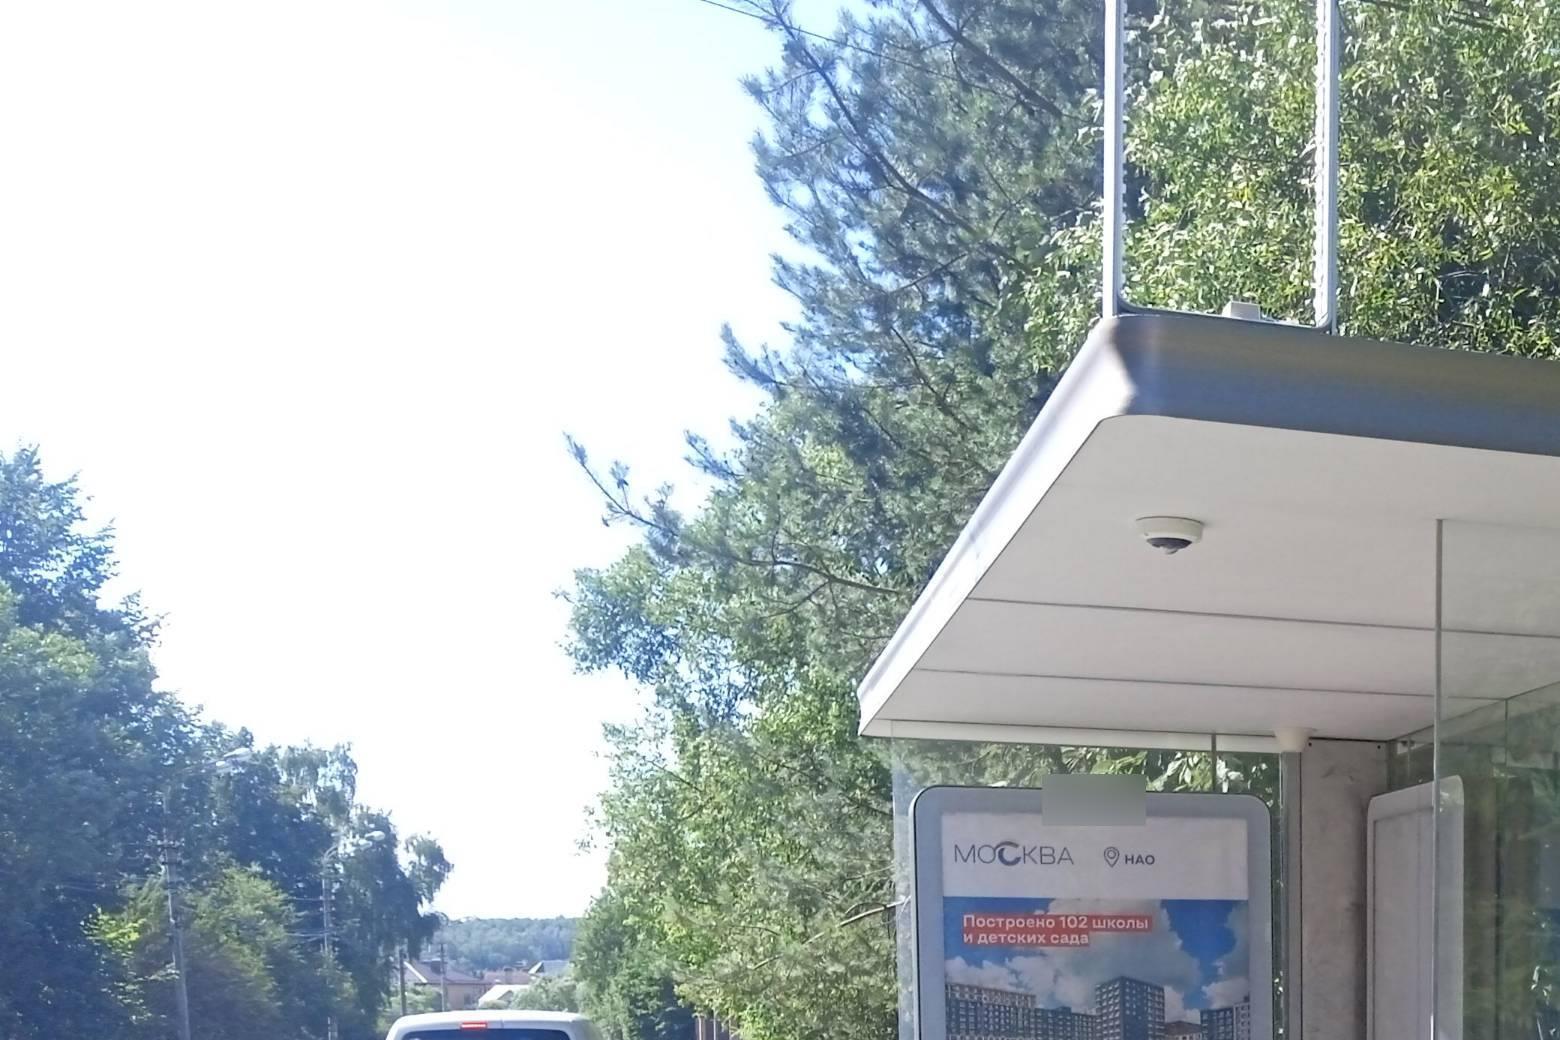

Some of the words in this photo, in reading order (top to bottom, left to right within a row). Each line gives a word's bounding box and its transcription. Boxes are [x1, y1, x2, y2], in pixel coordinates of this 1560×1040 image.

[954, 841, 1075, 867] МОСКВА
[1124, 854, 1156, 866] НАО
[963, 915, 1056, 931] Построено
[1060, 916, 1088, 929] 102
[1092, 918, 1149, 930] школы
[963, 934, 973, 944] и
[977, 934, 1047, 945] детских
[1050, 934, 1089, 945] сада
